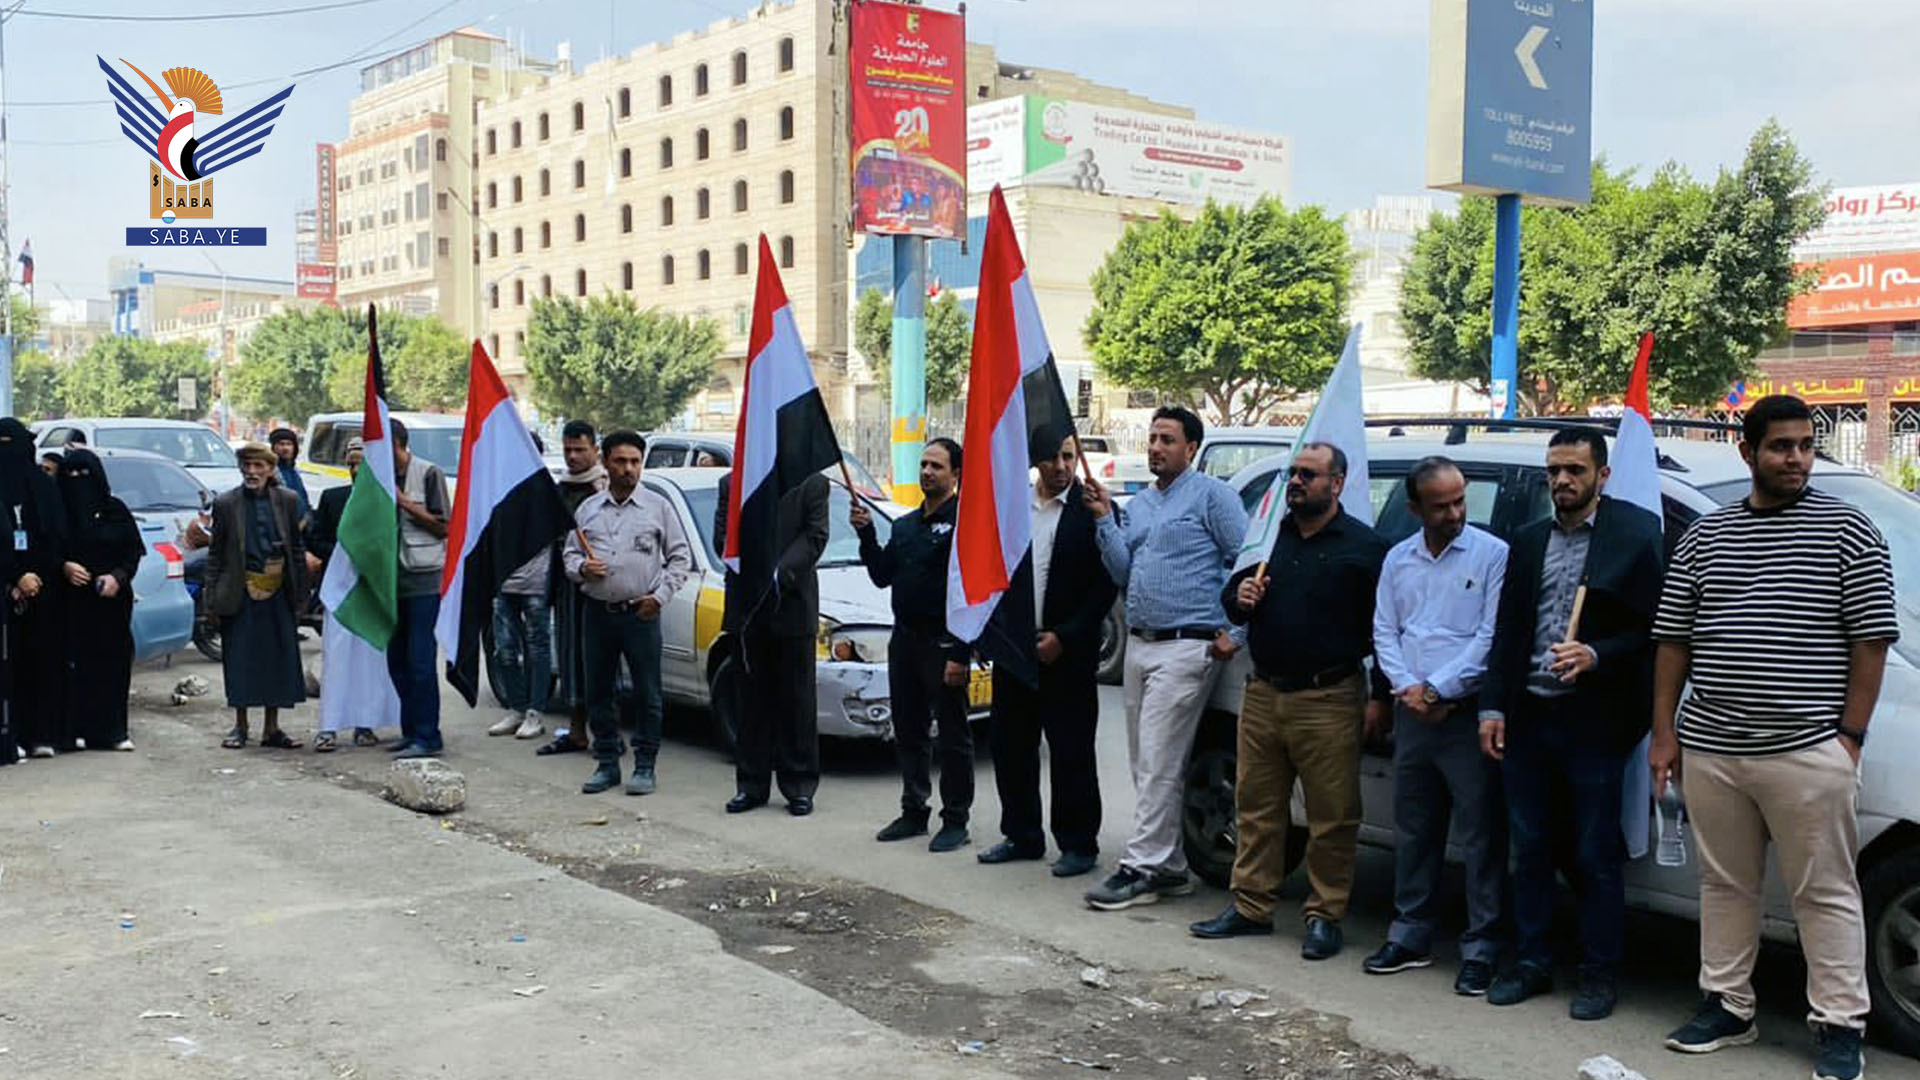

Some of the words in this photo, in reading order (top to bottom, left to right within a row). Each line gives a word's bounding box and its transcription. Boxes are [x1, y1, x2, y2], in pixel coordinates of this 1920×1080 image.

[897, 33, 929, 52] جامعة
[872, 45, 918, 63] الحديثة
[895, 106, 930, 138] 20
[1094, 127, 1128, 143] Trading
[1876, 190, 1920, 215] ركز
